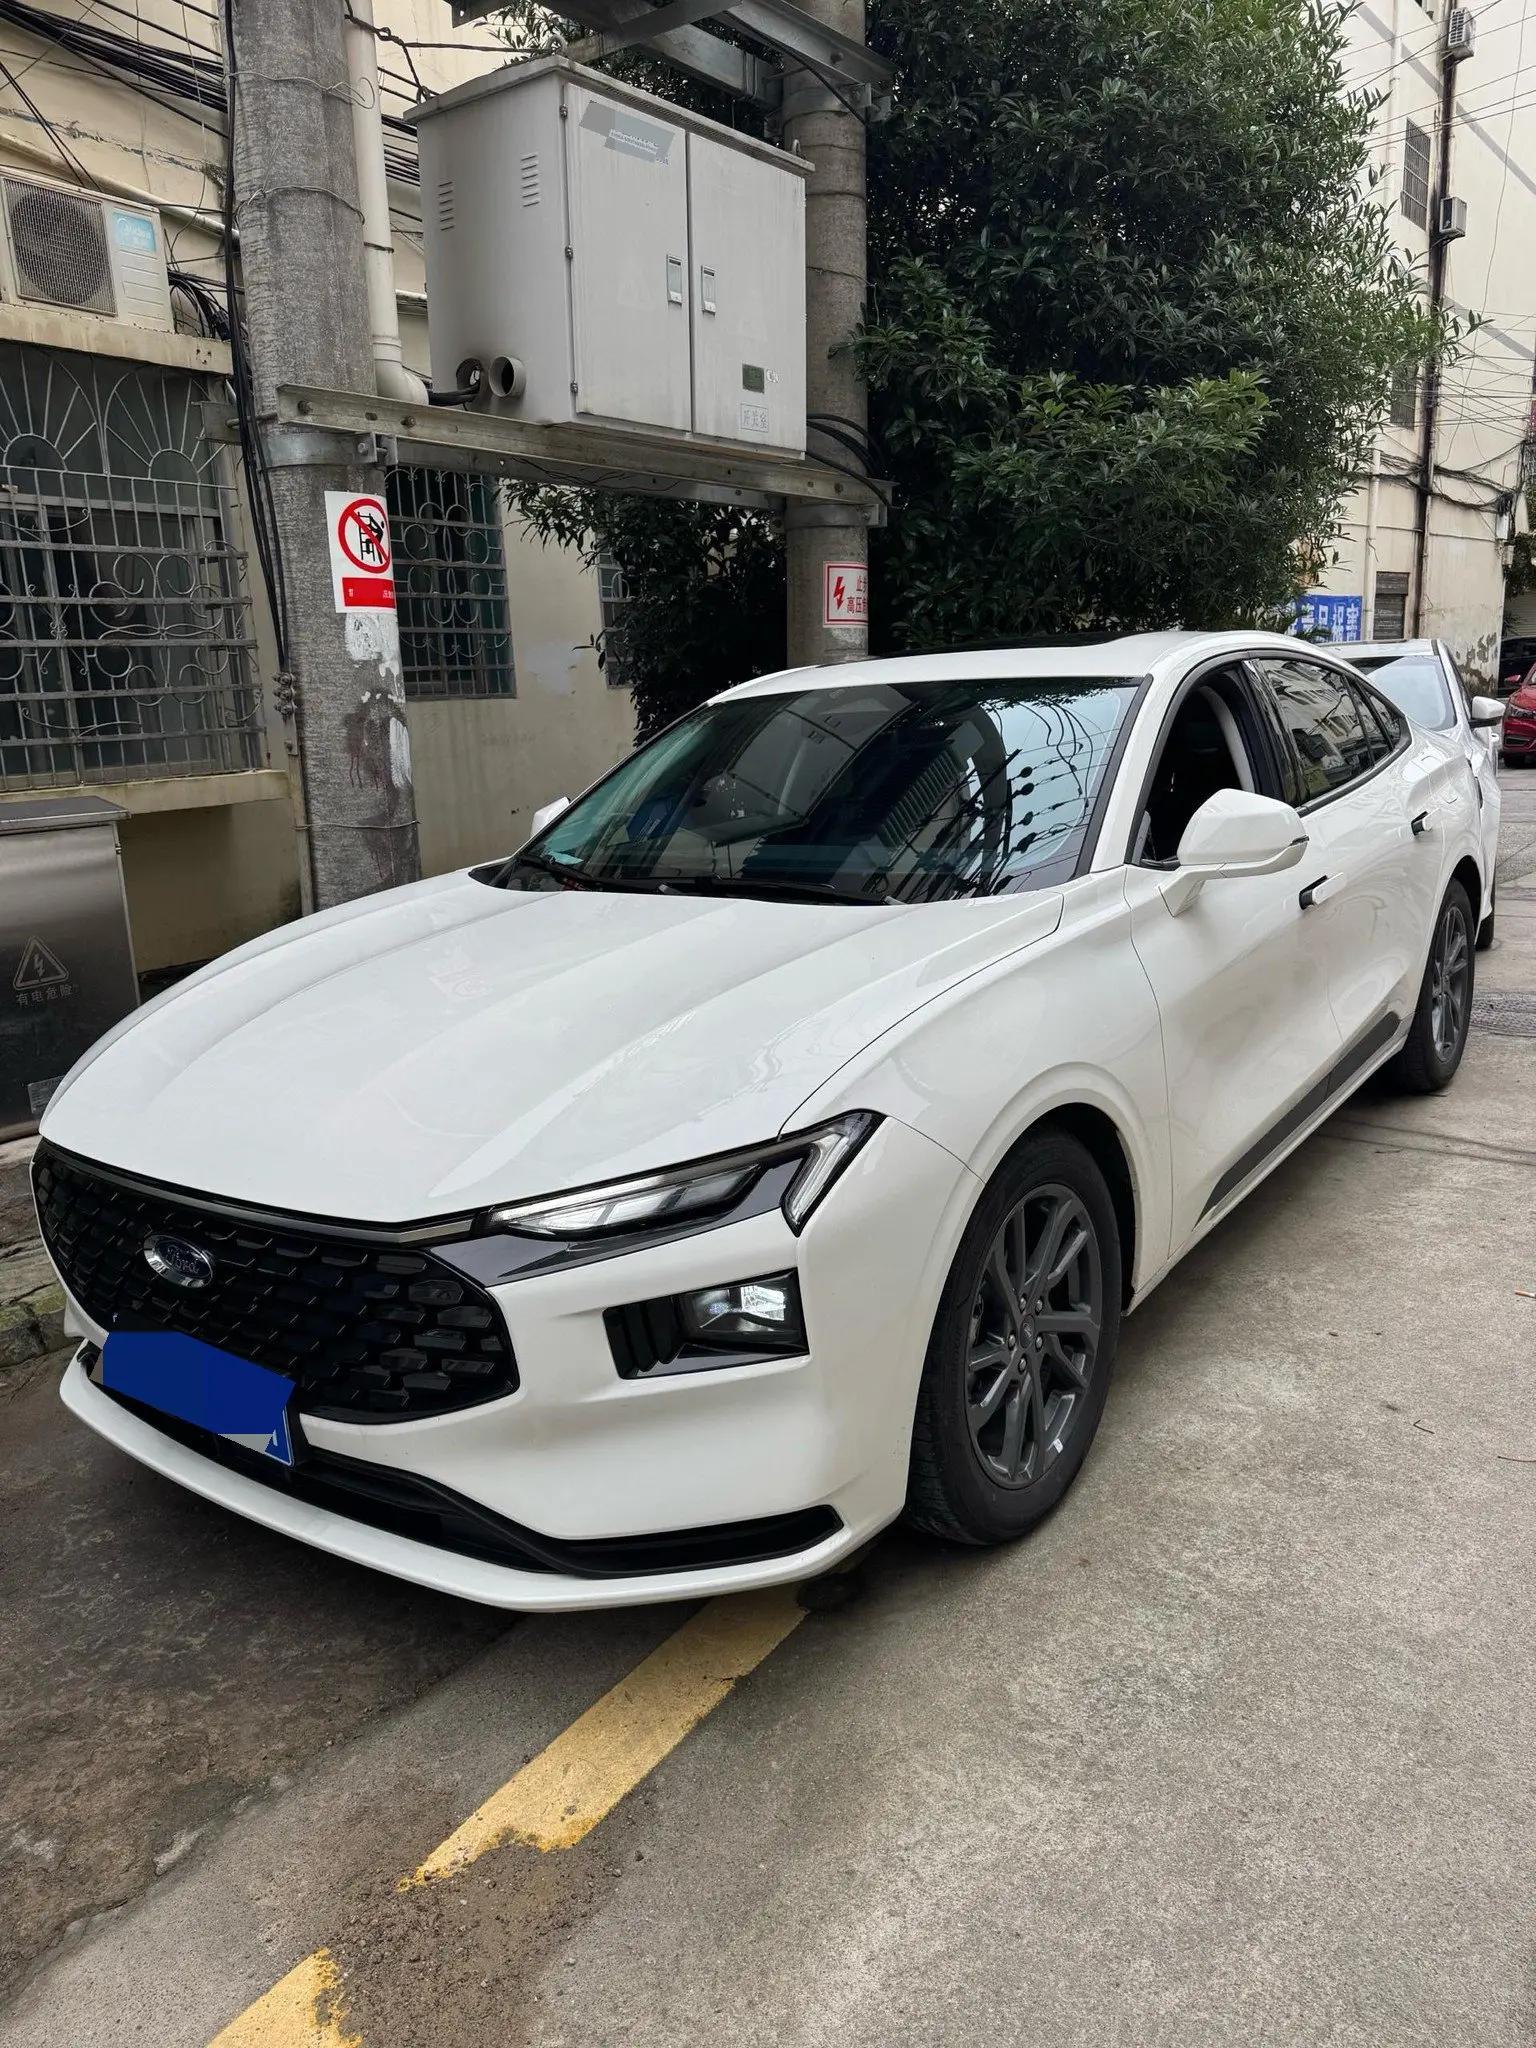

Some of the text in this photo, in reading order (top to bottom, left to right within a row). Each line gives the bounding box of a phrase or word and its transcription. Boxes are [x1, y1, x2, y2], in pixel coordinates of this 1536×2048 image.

[16, 984, 73, 1008] 有电危险
[164, 1244, 201, 1275] Ford
